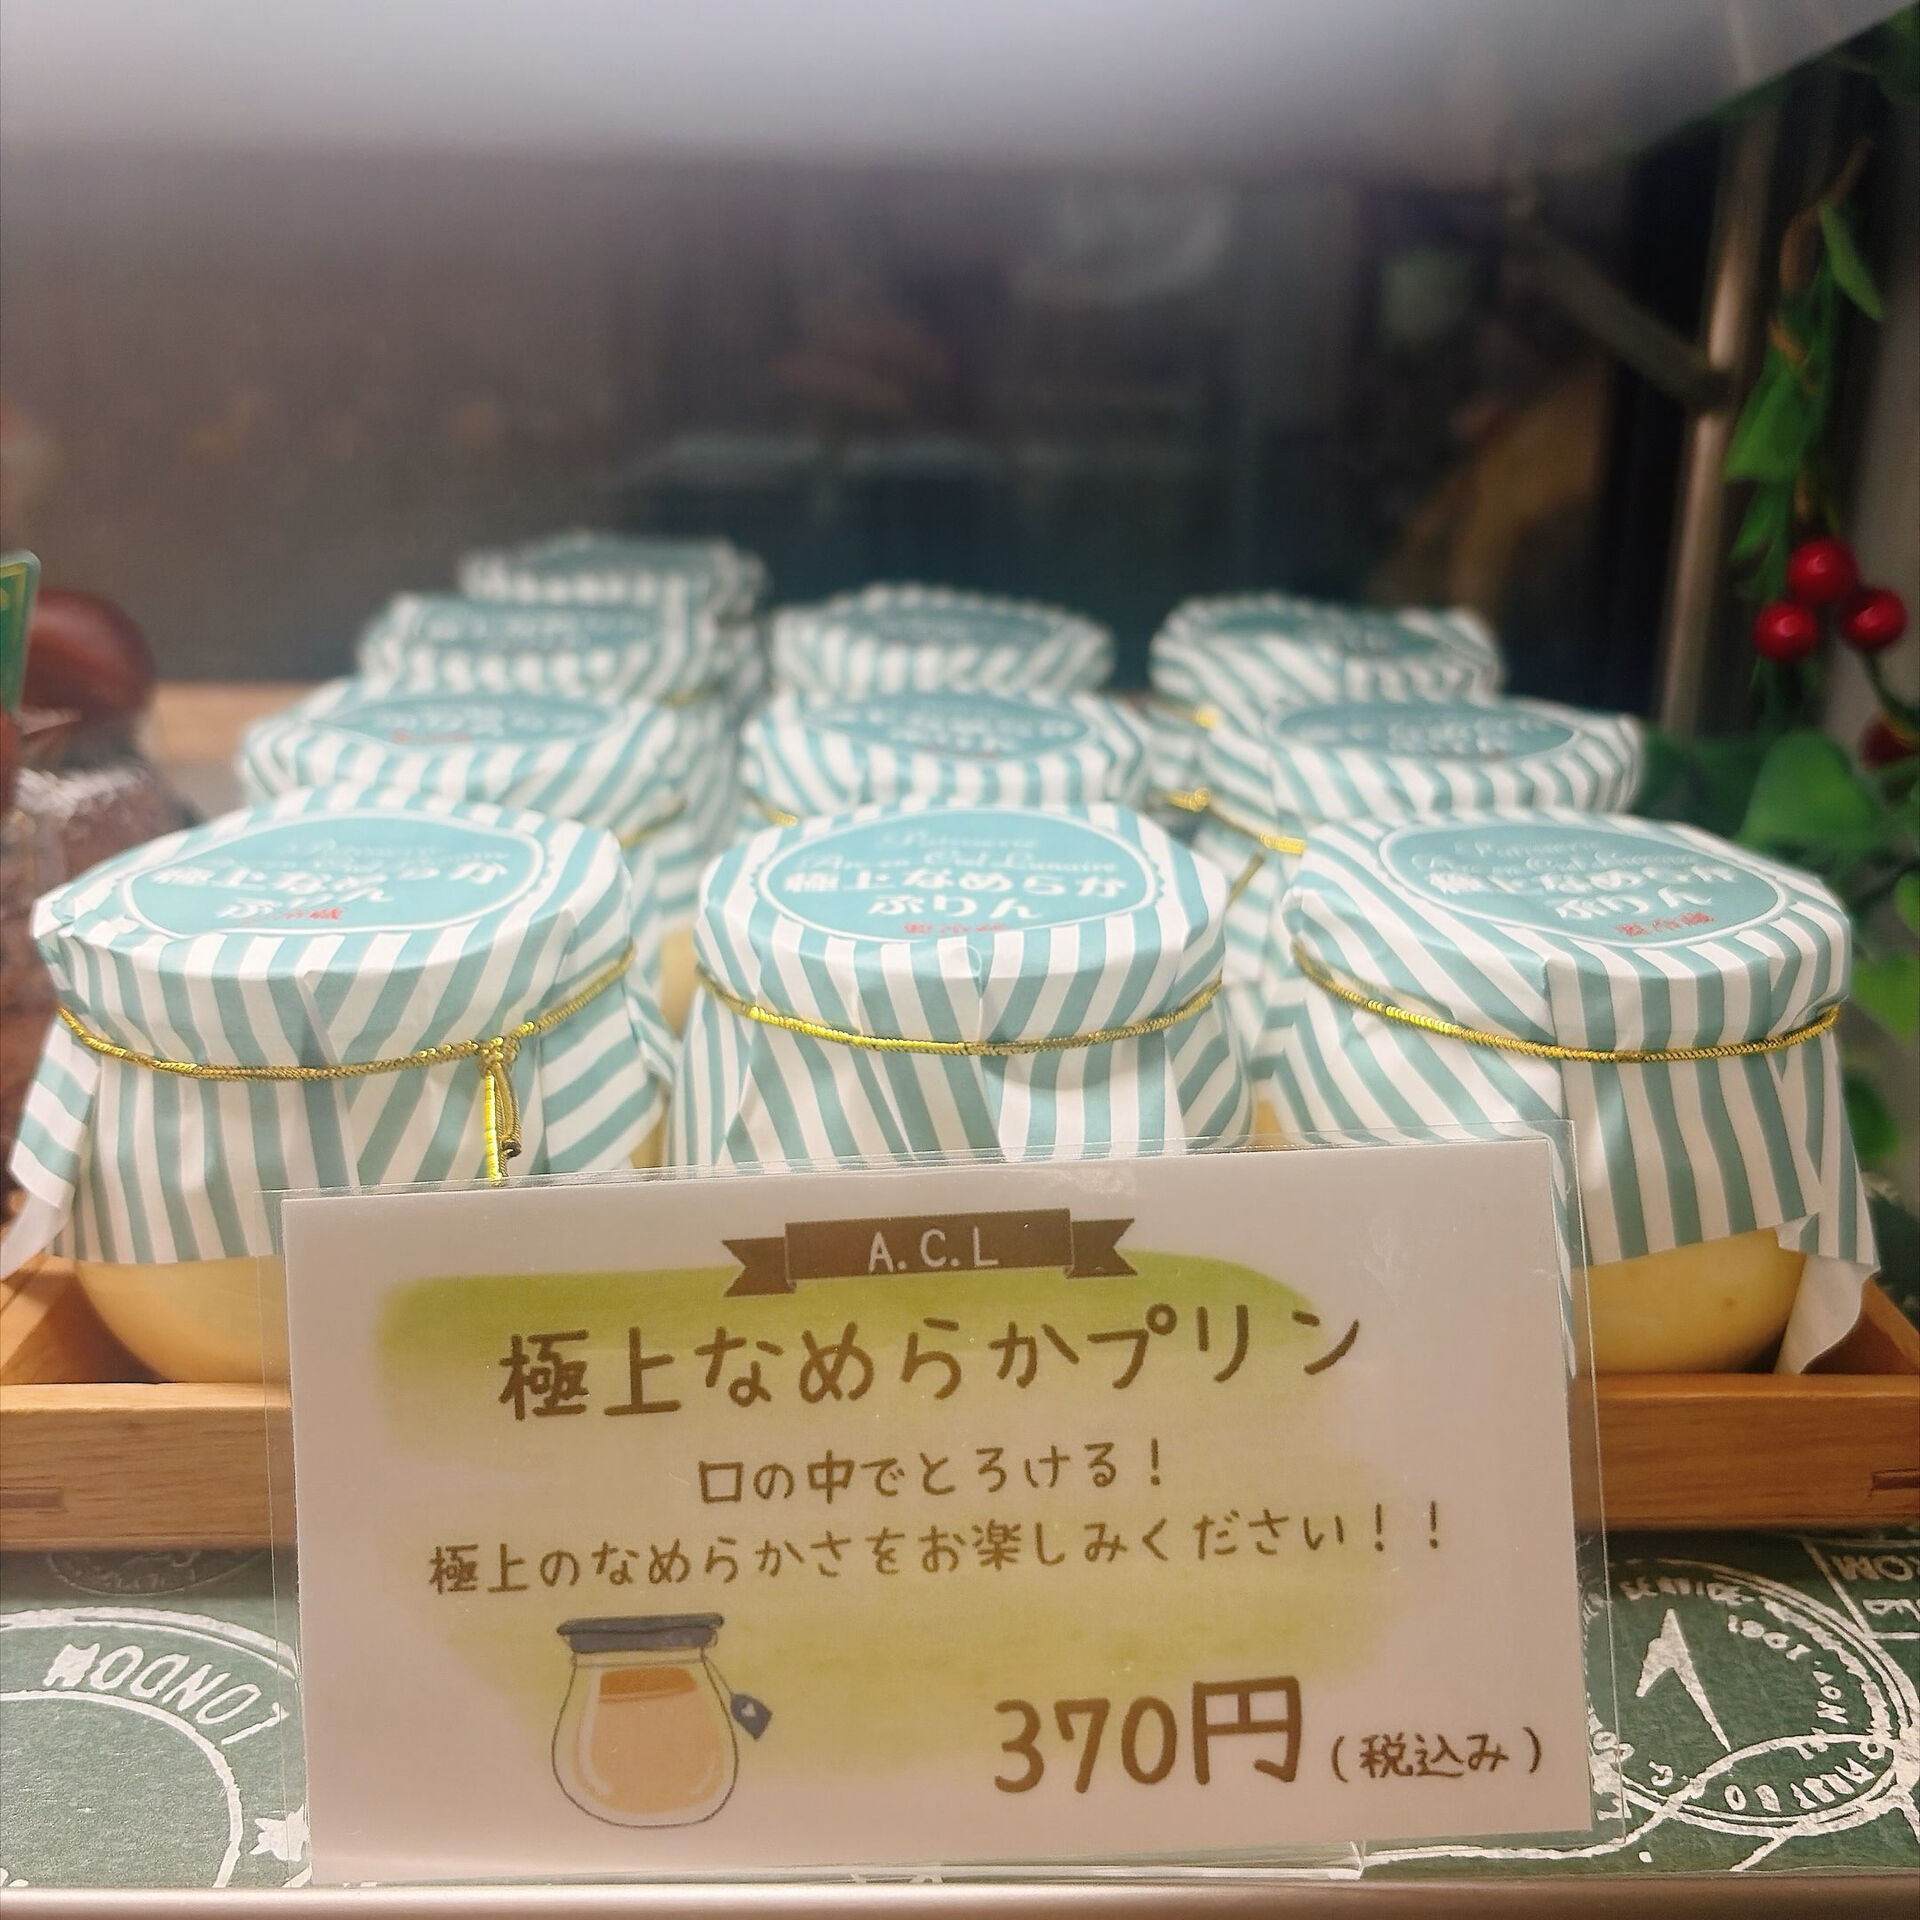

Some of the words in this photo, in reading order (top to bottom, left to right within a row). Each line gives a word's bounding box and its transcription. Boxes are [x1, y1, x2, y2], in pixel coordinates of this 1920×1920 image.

[868, 1226, 999, 1273] A.C.L
[499, 1303, 1360, 1421] 極上なめらかプリン
[699, 1438, 1162, 1504] 口の中でとろける！
[994, 1675, 1301, 1794] 370円
